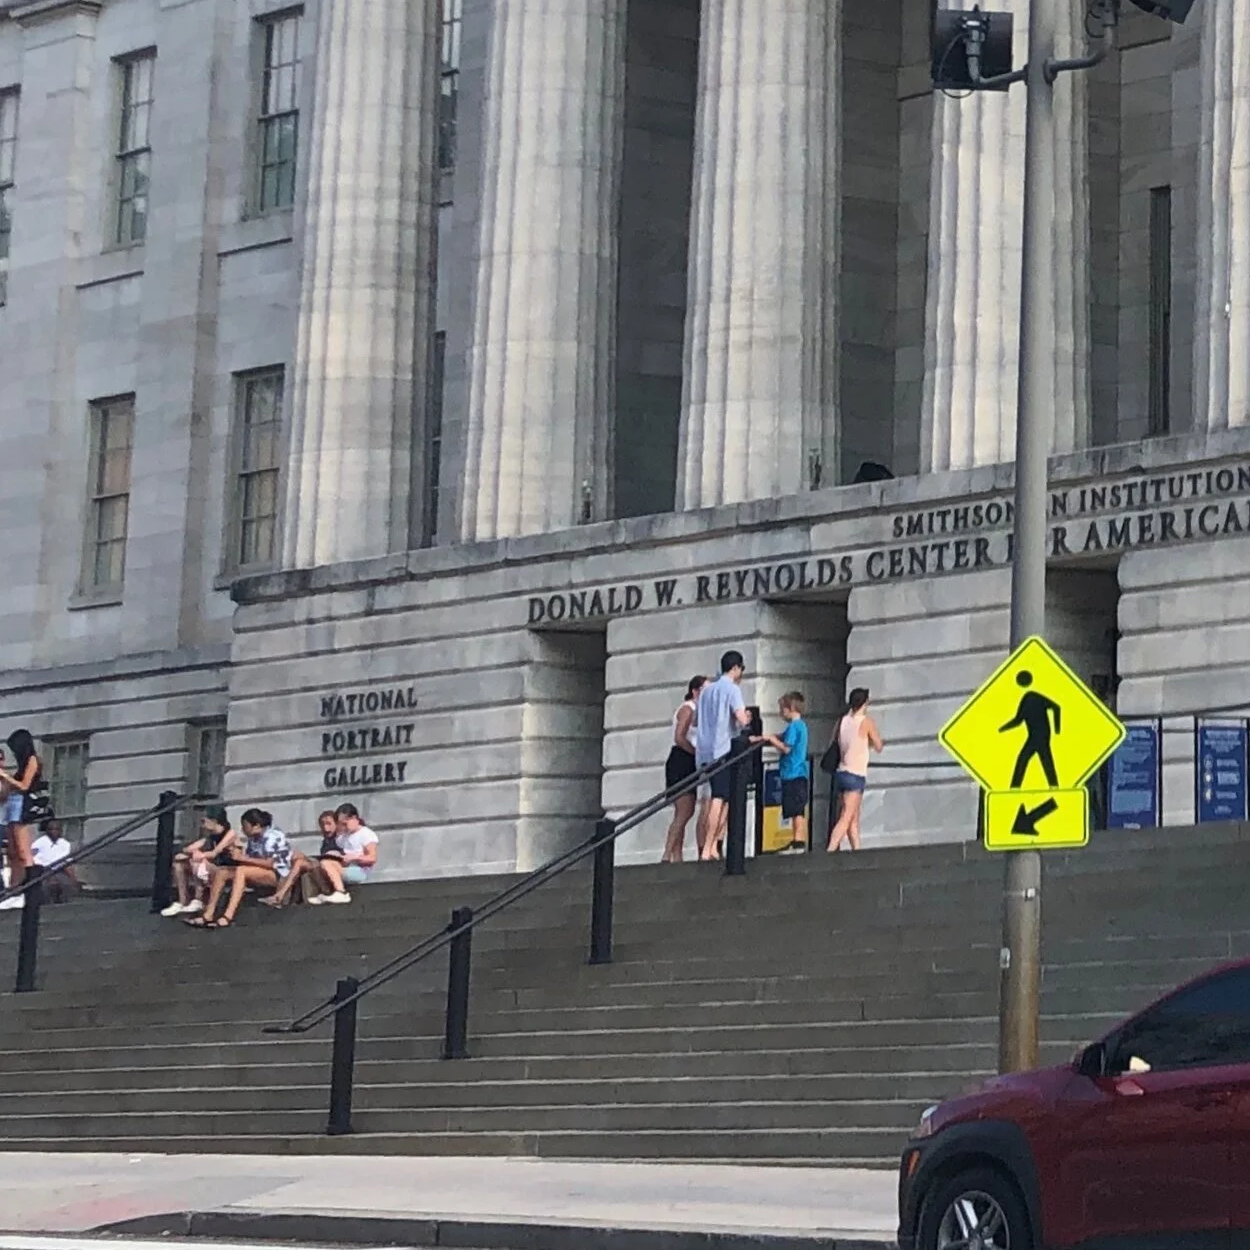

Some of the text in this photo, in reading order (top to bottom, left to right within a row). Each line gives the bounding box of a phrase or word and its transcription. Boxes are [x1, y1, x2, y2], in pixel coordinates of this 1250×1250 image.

[893, 492, 1068, 538] SMITHSONN
[528, 584, 643, 624] DONALD
[654, 579, 683, 607] W.
[697, 555, 853, 602] REYNOLDS
[866, 537, 994, 580] CENTER
[320, 687, 418, 718] NATIONAL
[321, 723, 415, 752] PORTRAIT
[323, 760, 408, 789] GALLERY
